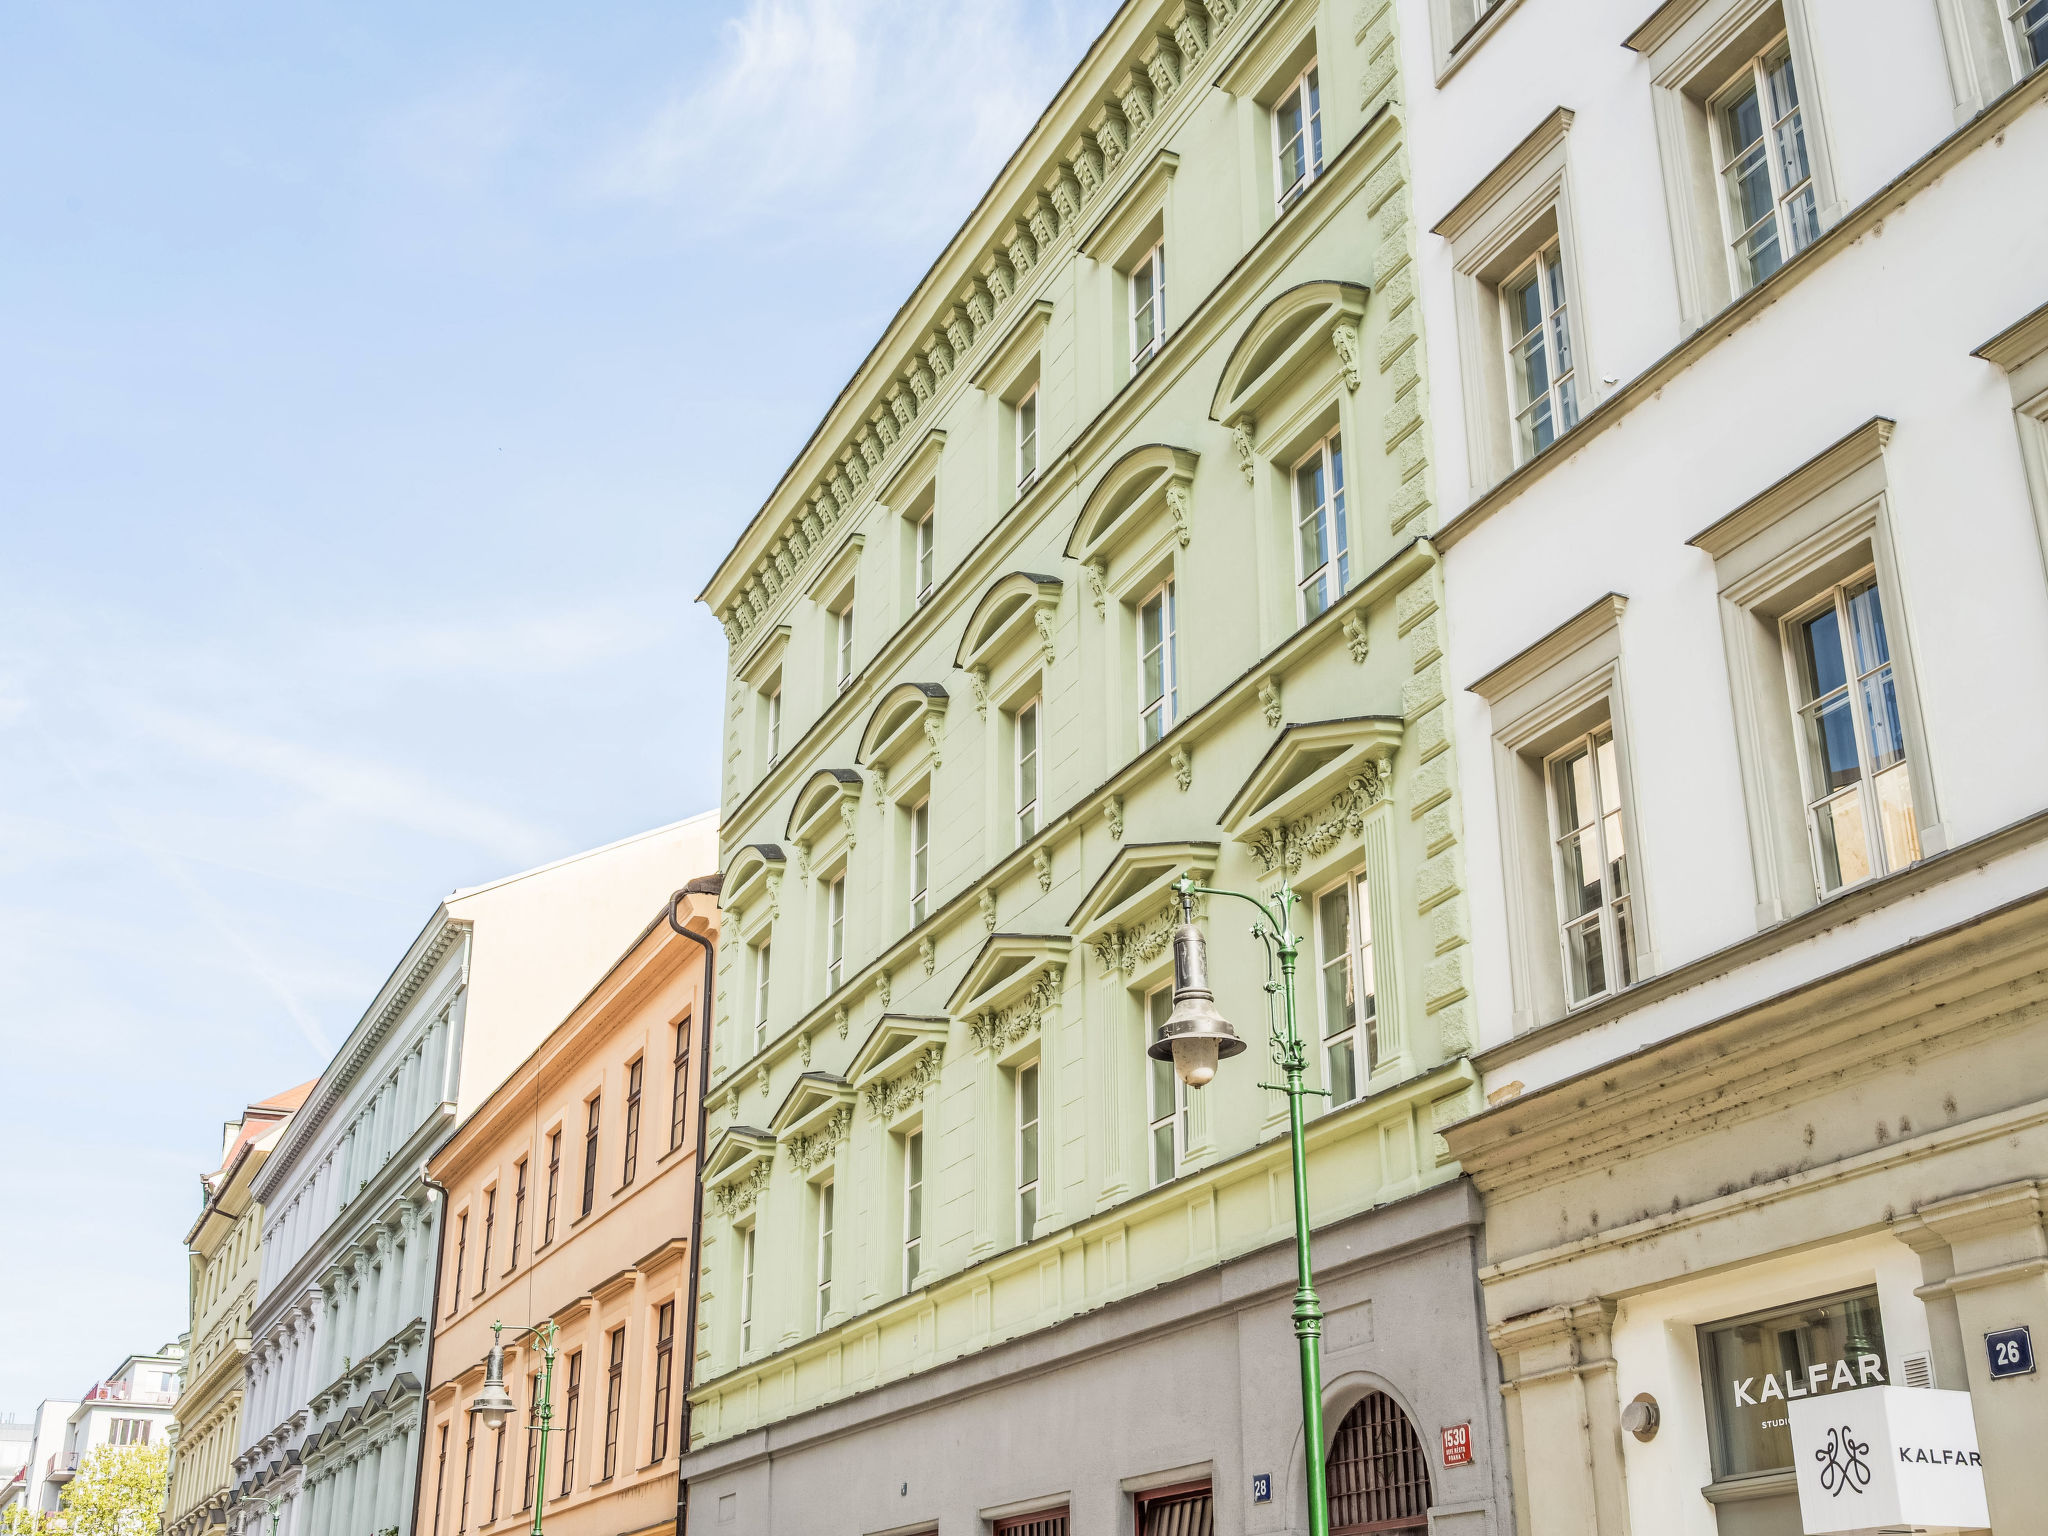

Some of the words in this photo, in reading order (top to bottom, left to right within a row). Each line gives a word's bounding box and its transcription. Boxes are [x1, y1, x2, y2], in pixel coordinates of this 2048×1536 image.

[1995, 1340, 2020, 1366] 26
[1733, 1353, 1885, 1408] KALFAR
[1761, 1417, 1790, 1429] STUDI
[1445, 1428, 1466, 1447] 1530
[1899, 1447, 1983, 1467] KALFAR
[1254, 1479, 1267, 1497] 28
